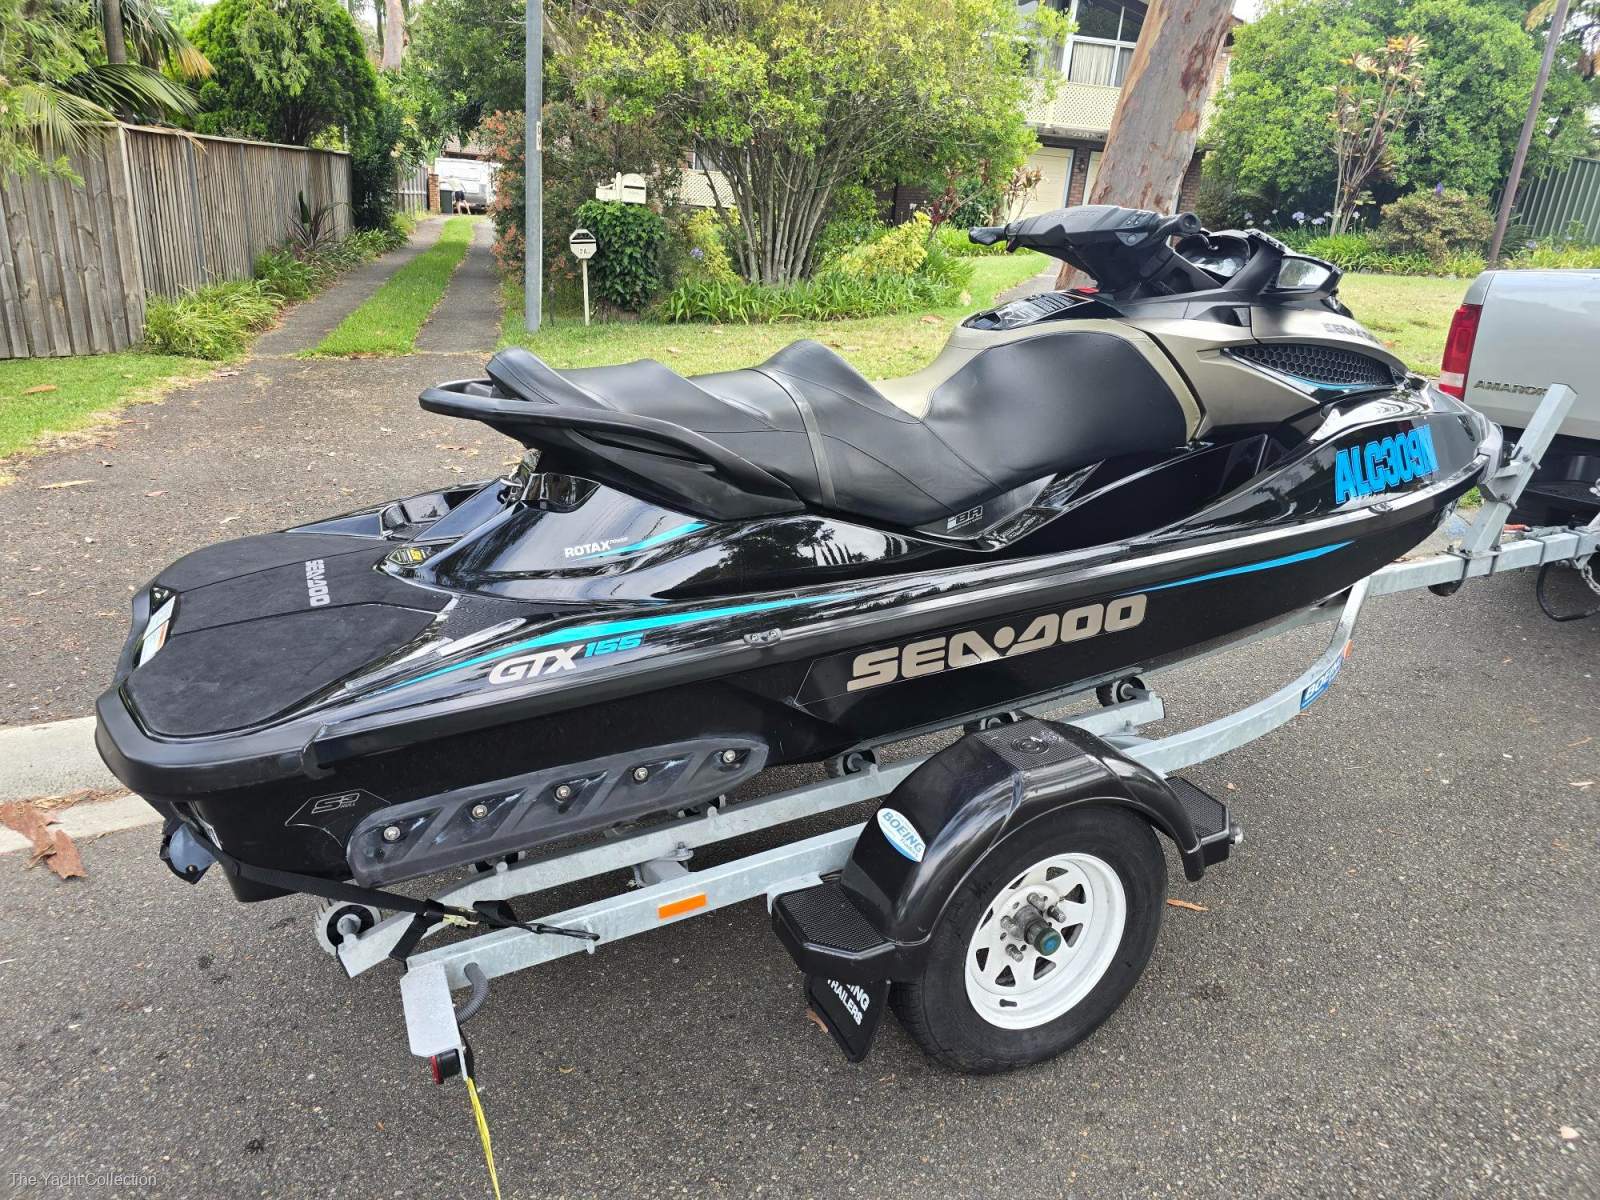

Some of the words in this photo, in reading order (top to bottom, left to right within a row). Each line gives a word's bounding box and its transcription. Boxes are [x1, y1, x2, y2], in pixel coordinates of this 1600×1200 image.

[564, 541, 610, 558] ROTAX
[488, 645, 585, 685] GTX
[584, 633, 644, 658] 155
[882, 811, 925, 853] BOEING
